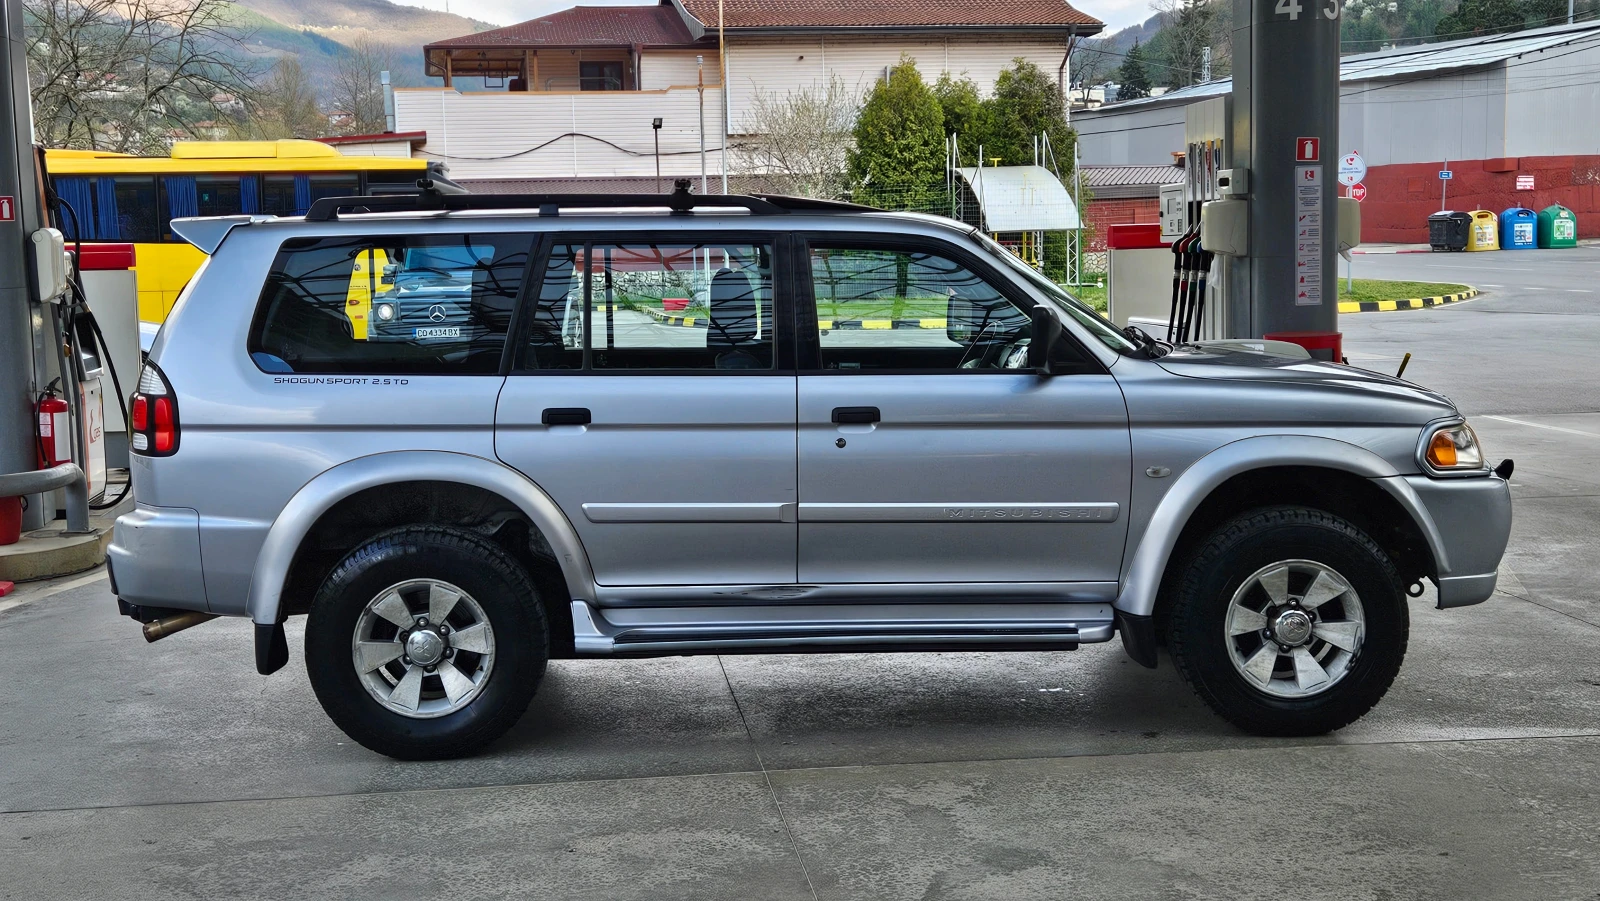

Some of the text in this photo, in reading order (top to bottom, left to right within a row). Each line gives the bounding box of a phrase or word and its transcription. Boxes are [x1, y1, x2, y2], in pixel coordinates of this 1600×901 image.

[1275, 0, 1303, 21] 4
[1353, 188, 1365, 196] TOP
[948, 508, 1102, 518] MITSUBISHI
